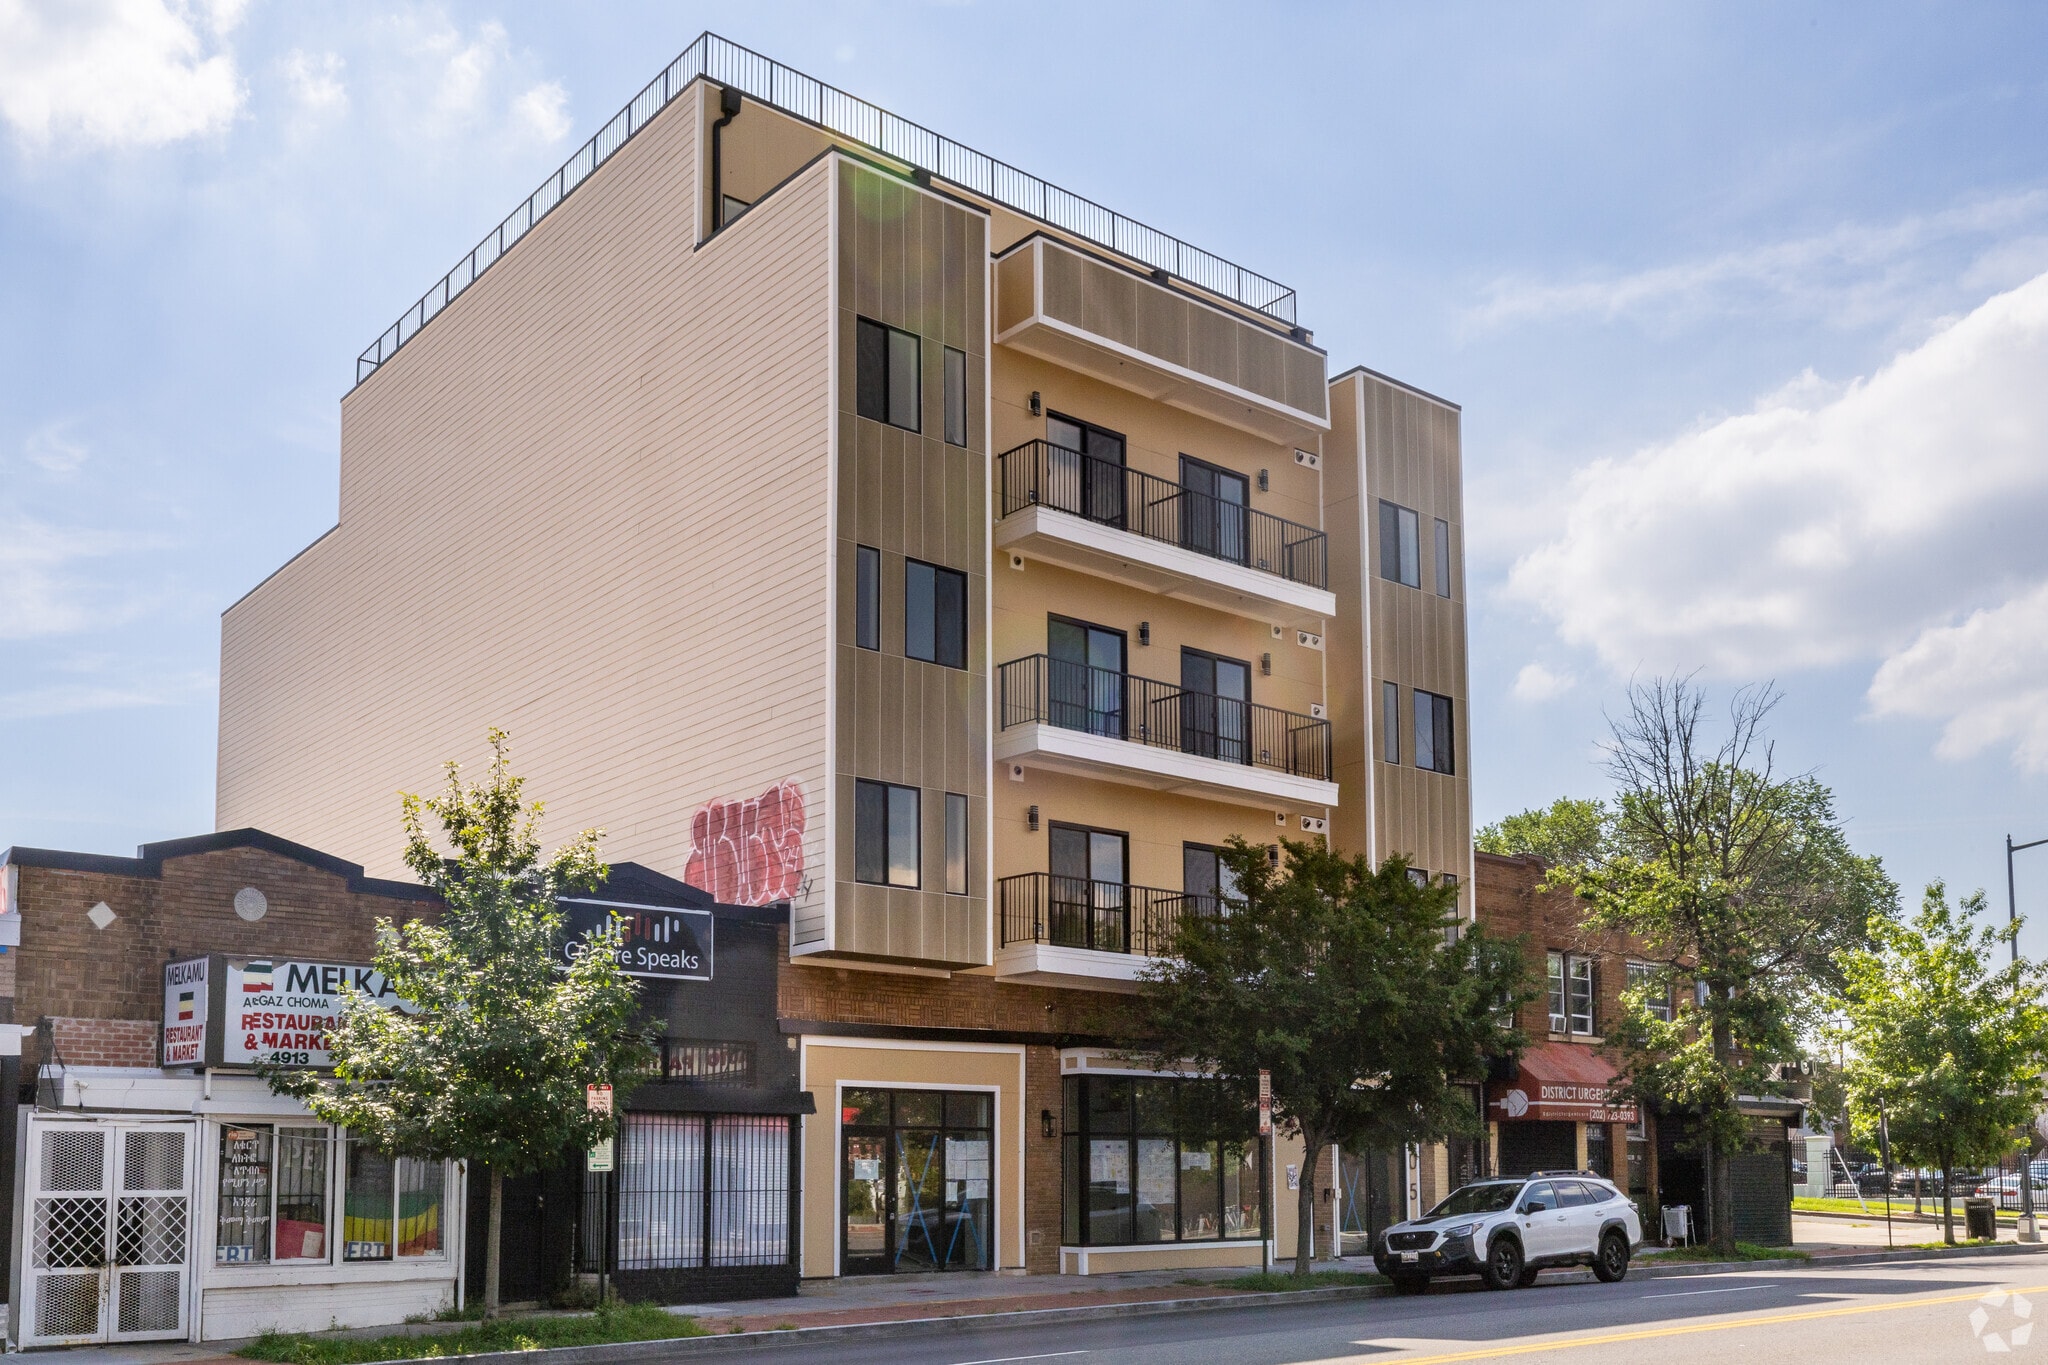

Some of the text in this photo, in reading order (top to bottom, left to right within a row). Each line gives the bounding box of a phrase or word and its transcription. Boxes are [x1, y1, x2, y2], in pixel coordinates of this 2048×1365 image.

[637, 947, 699, 971] Speaks
[166, 961, 205, 986] MELKAMU
[286, 964, 403, 999] MELKA
[287, 996, 329, 1009] CHOMA
[165, 1024, 204, 1044] RESTAURANT
[244, 1033, 259, 1050] &
[165, 1043, 199, 1062] & MARKET
[270, 1051, 309, 1064] 4913
[1541, 1085, 1577, 1100] DISTRICT
[1589, 1109, 1606, 1121] (202)
